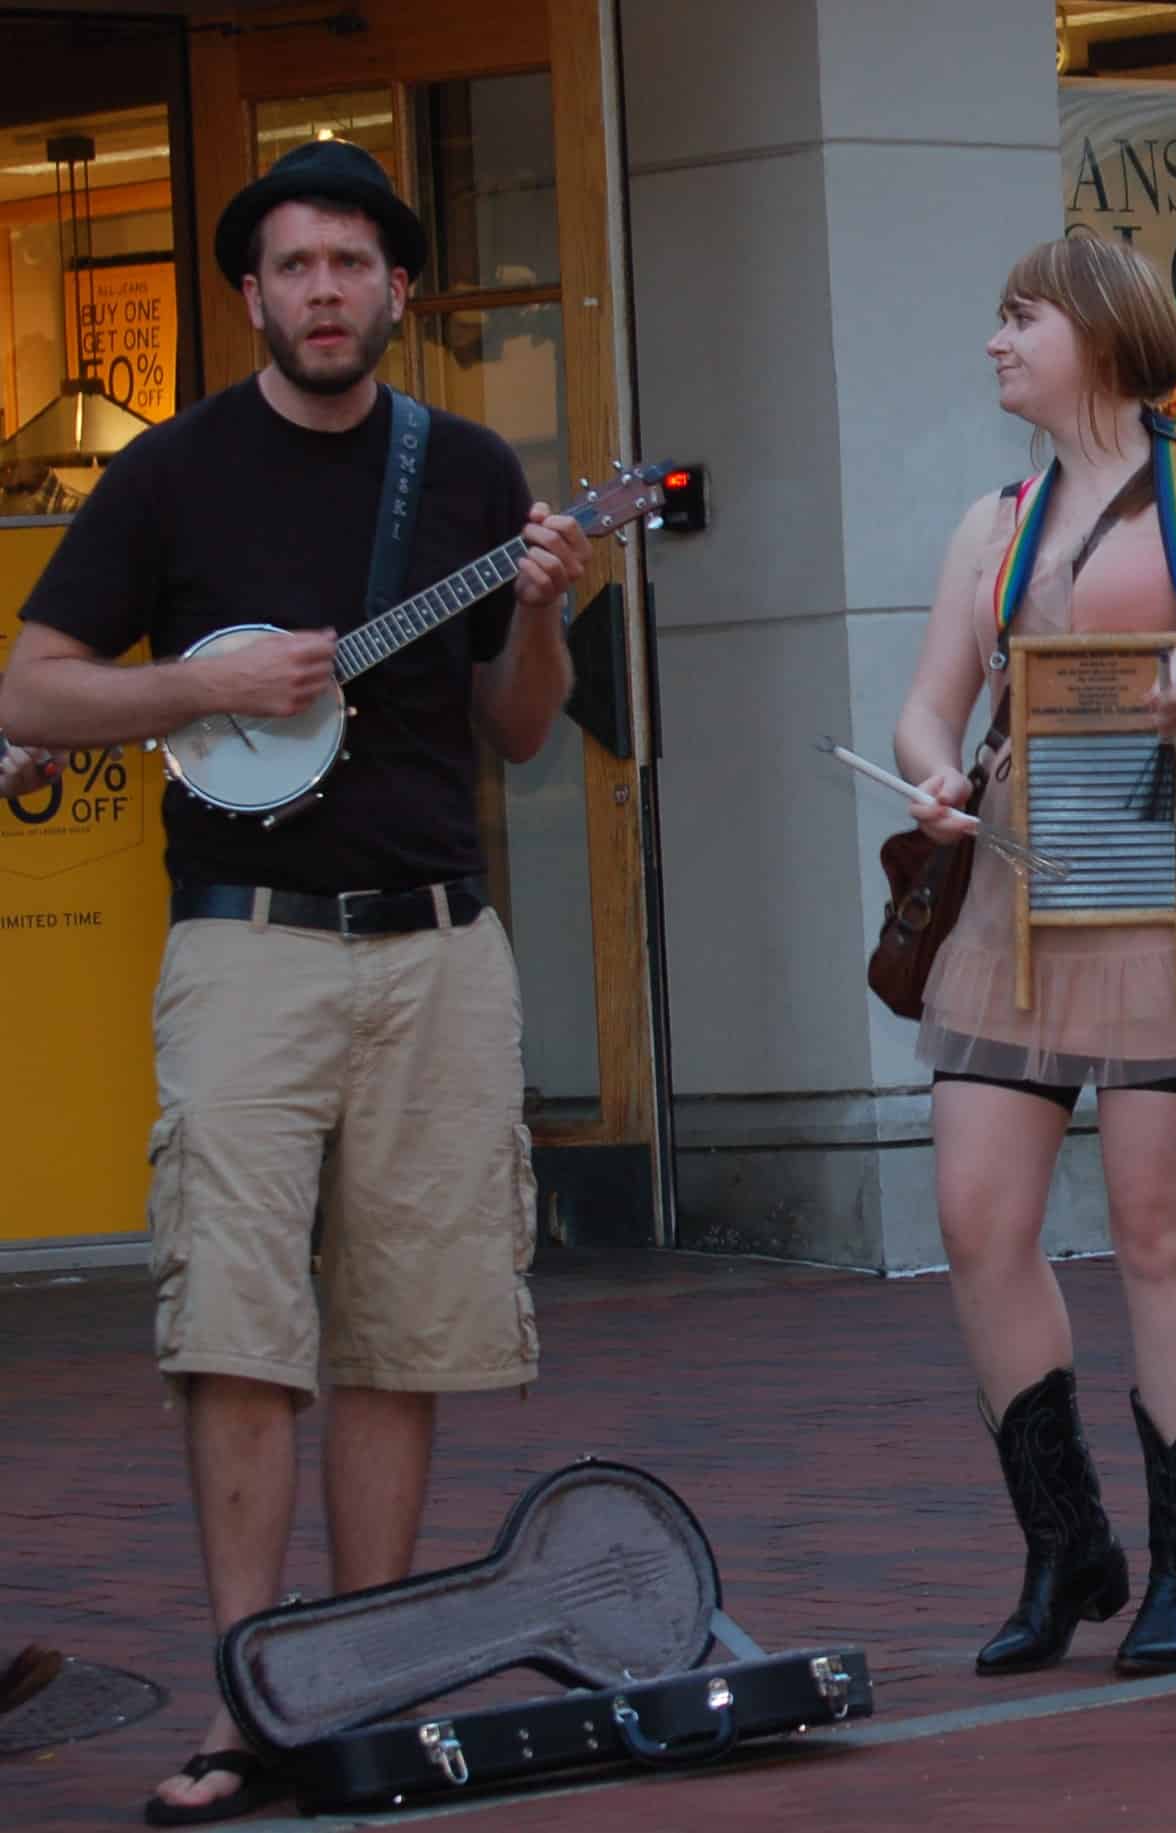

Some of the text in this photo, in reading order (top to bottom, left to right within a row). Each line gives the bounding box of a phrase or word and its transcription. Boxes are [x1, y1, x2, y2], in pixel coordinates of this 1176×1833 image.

[81, 299, 160, 327] BUY ONE
[83, 326, 160, 353] GET ONE
[137, 389, 164, 408] OFF
[71, 797, 128, 823] OFF
[64, 911, 102, 928] TIME
